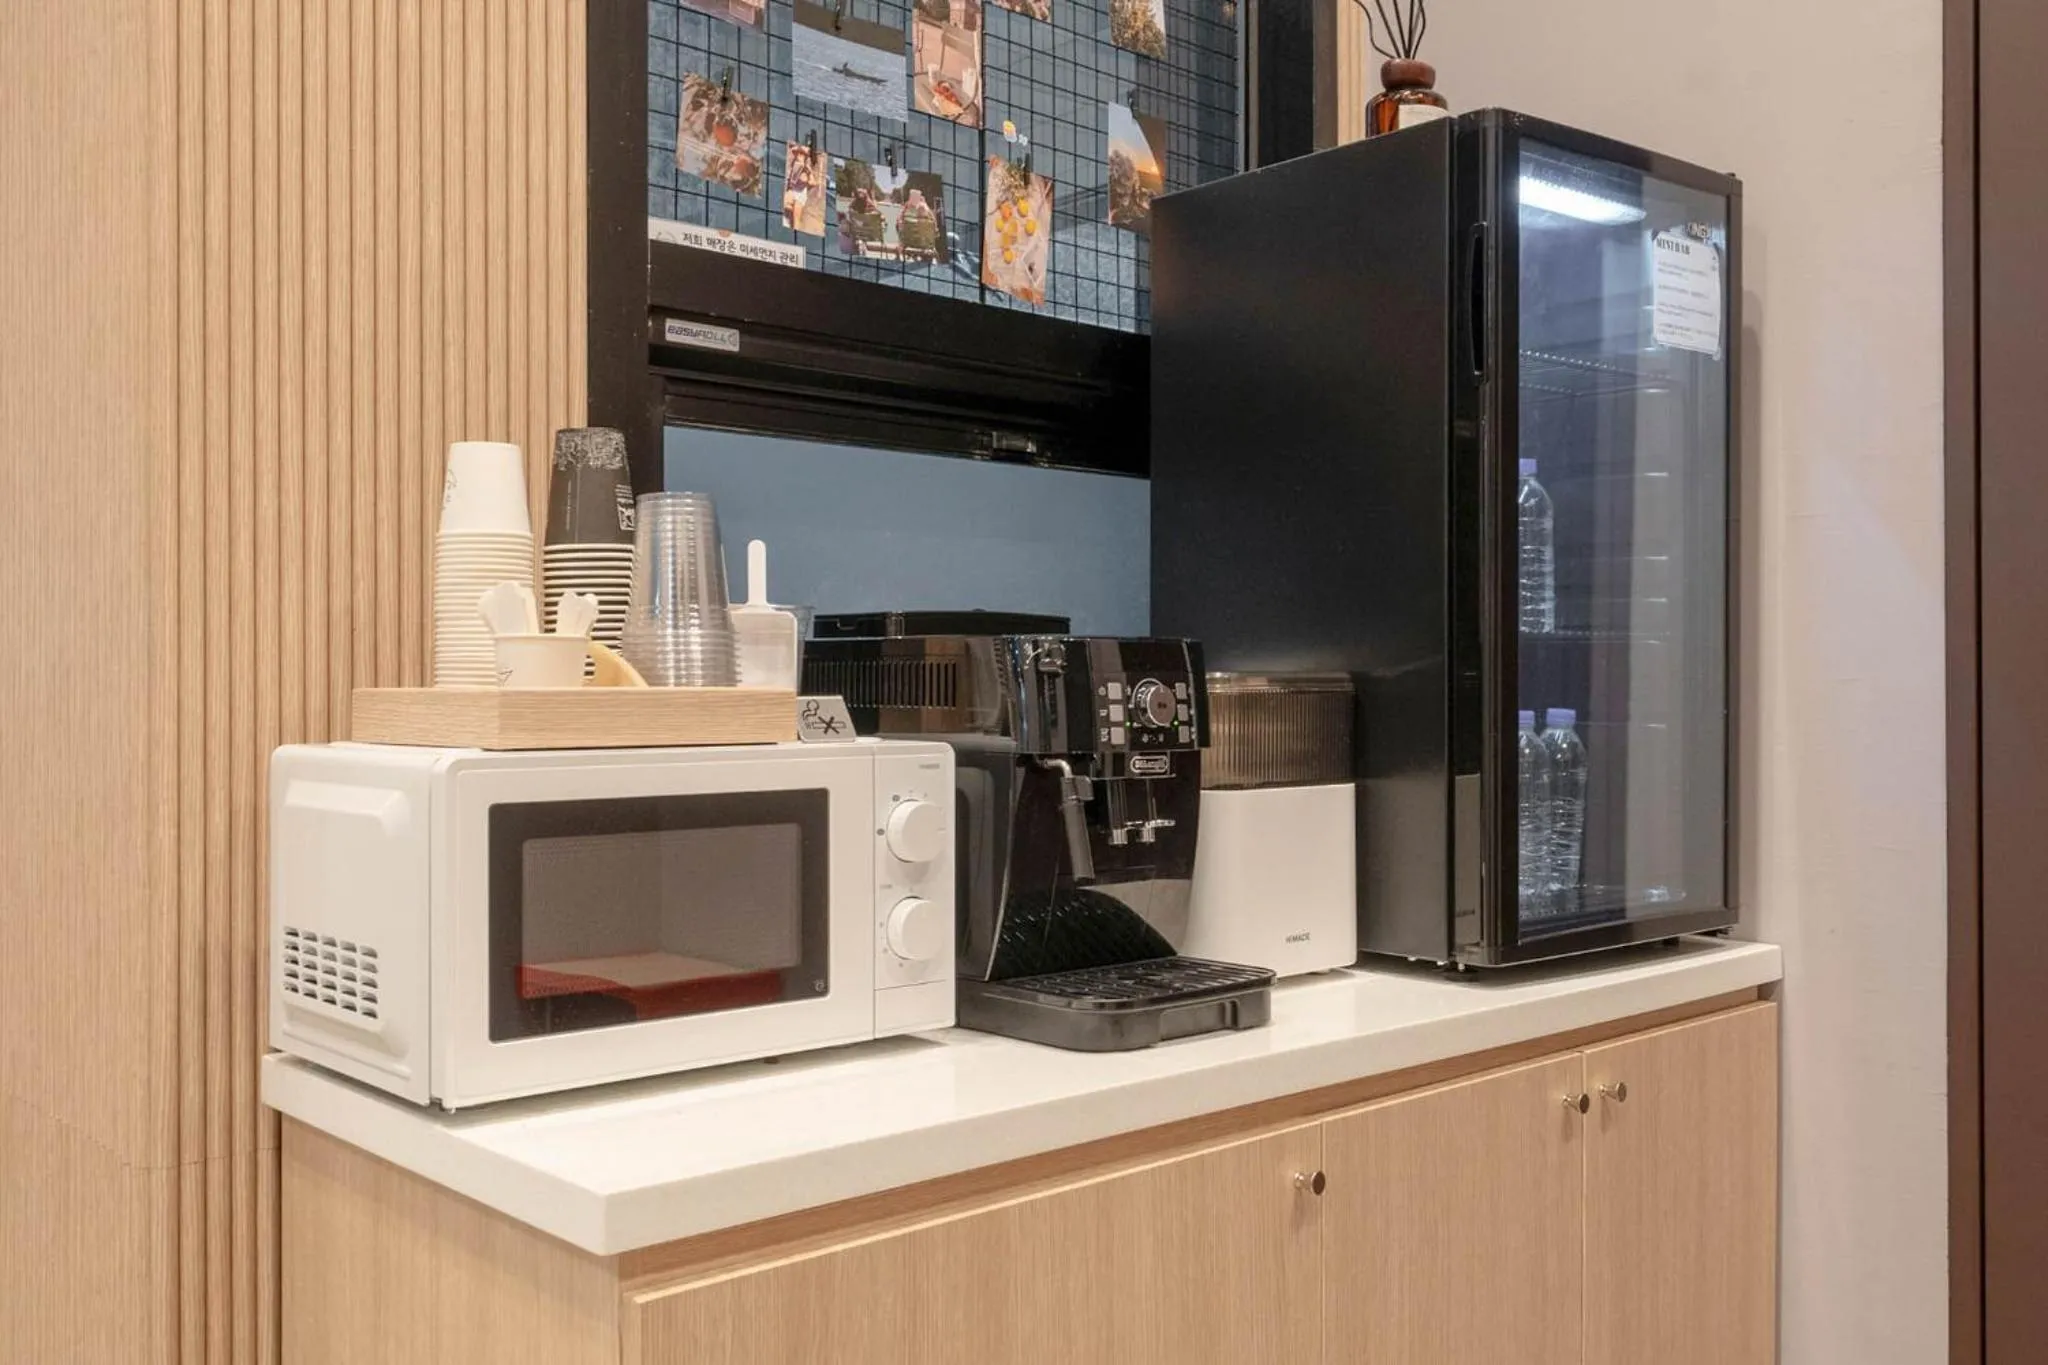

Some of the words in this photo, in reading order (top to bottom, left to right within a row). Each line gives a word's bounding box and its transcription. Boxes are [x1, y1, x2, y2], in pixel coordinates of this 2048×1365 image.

[706, 237, 737, 253] 매장은
[739, 245, 777, 262] 미세먼지
[779, 251, 799, 265] 관리
